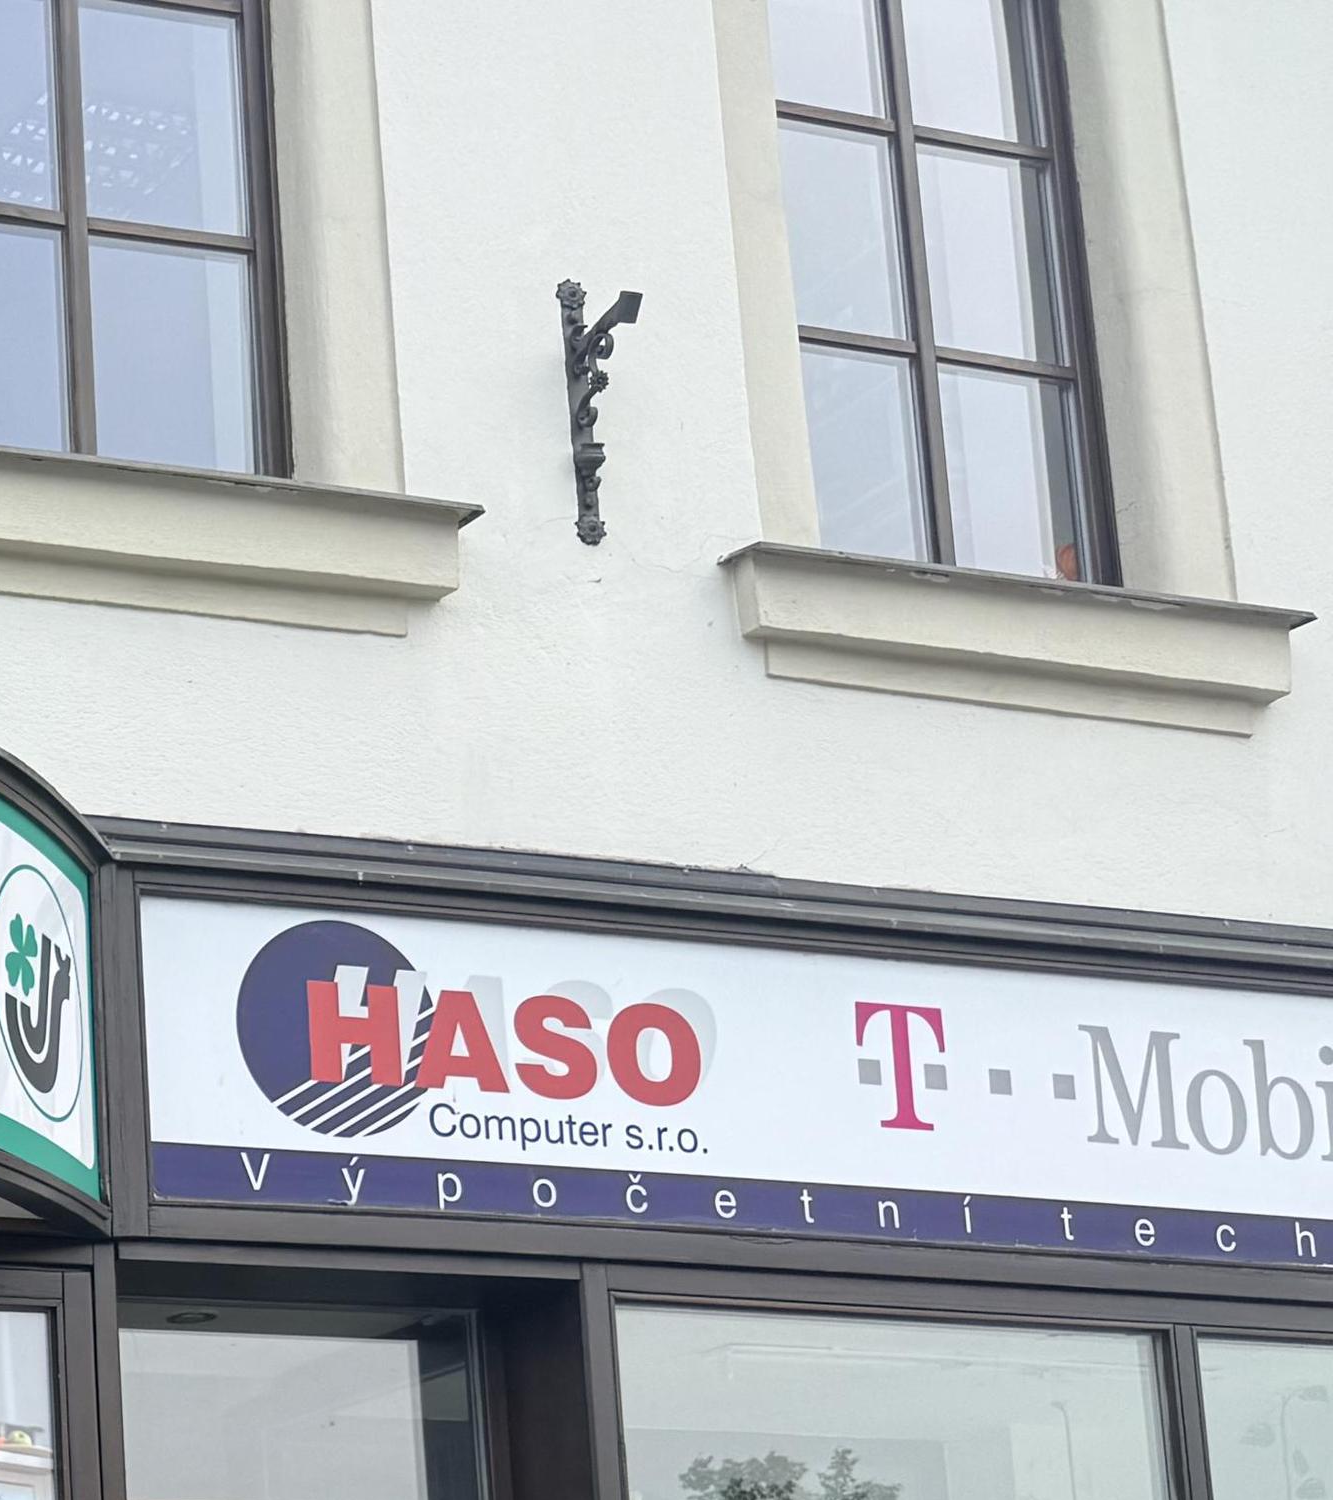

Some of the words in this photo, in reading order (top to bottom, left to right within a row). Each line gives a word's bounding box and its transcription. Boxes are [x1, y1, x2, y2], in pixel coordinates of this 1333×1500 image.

[307, 979, 701, 1107] HASO
[429, 1103, 612, 1152] Computer
[625, 1123, 708, 1154] s.r.o.
